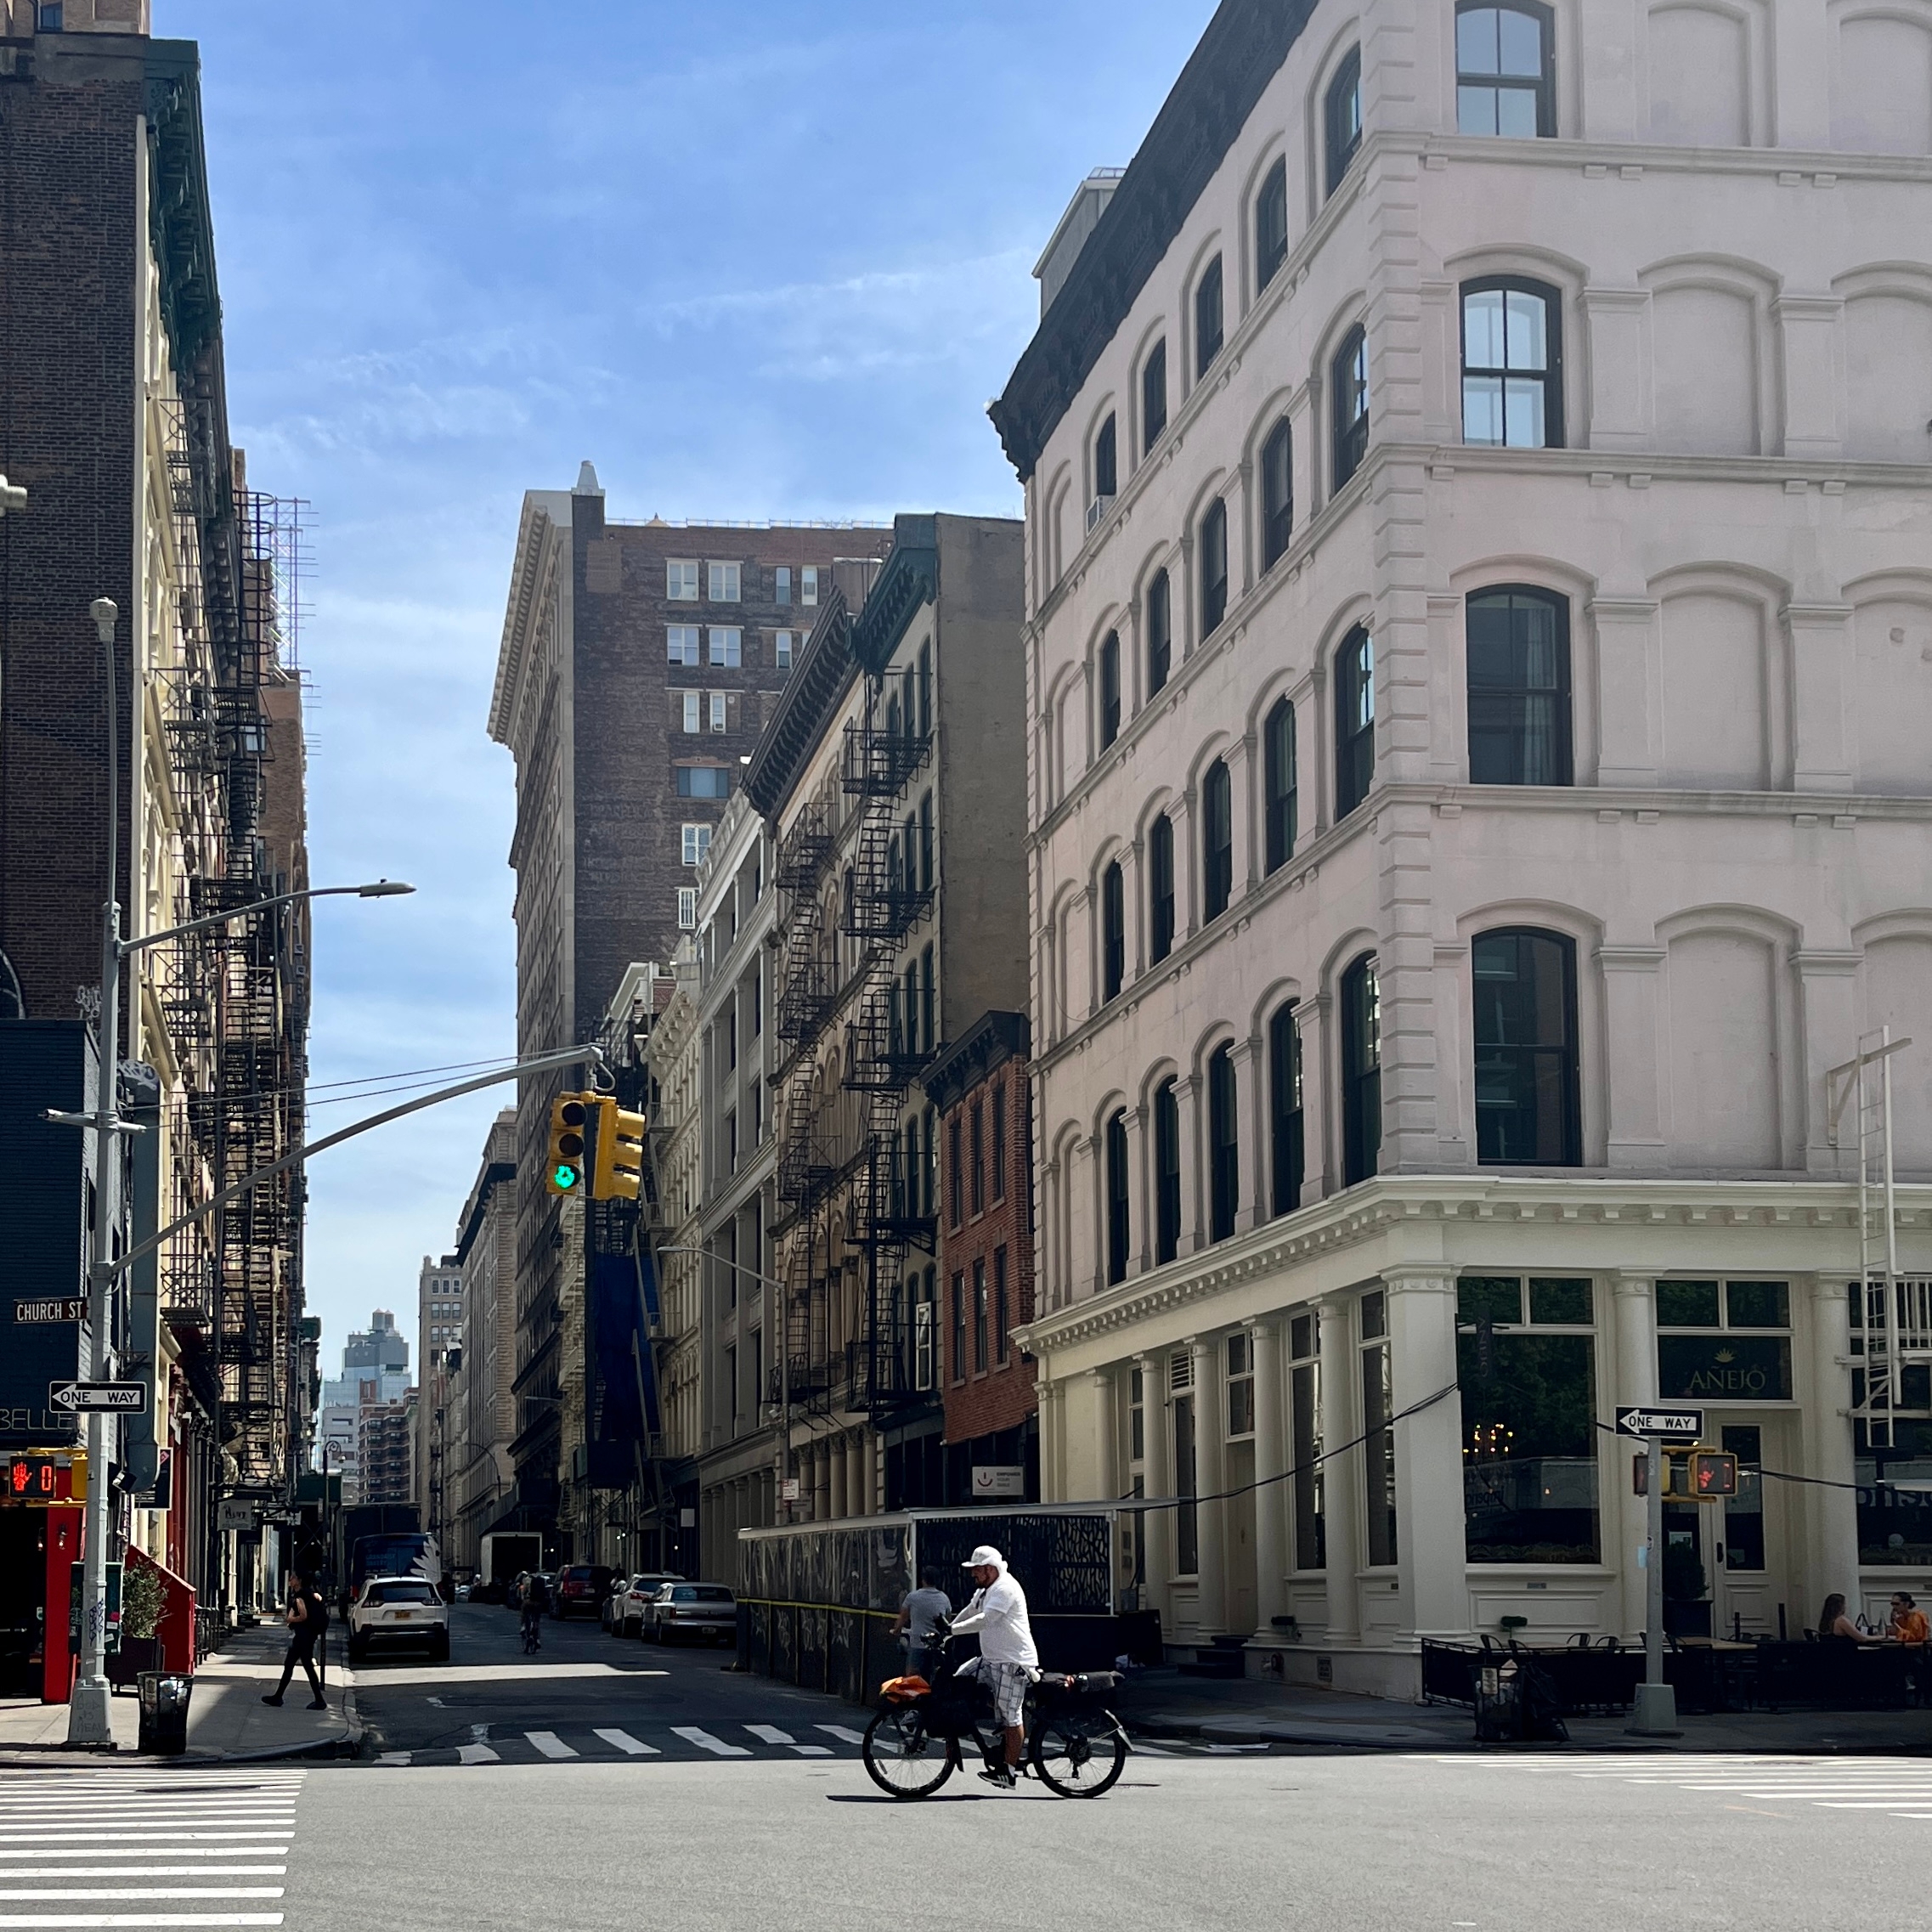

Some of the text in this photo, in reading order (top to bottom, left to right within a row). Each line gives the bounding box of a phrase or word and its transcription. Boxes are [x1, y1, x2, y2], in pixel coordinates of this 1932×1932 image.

[16, 1301, 83, 1321] CHURCH ST
[60, 1392, 137, 1404] ONE WAY
[1629, 1415, 1691, 1429] ONE WAY
